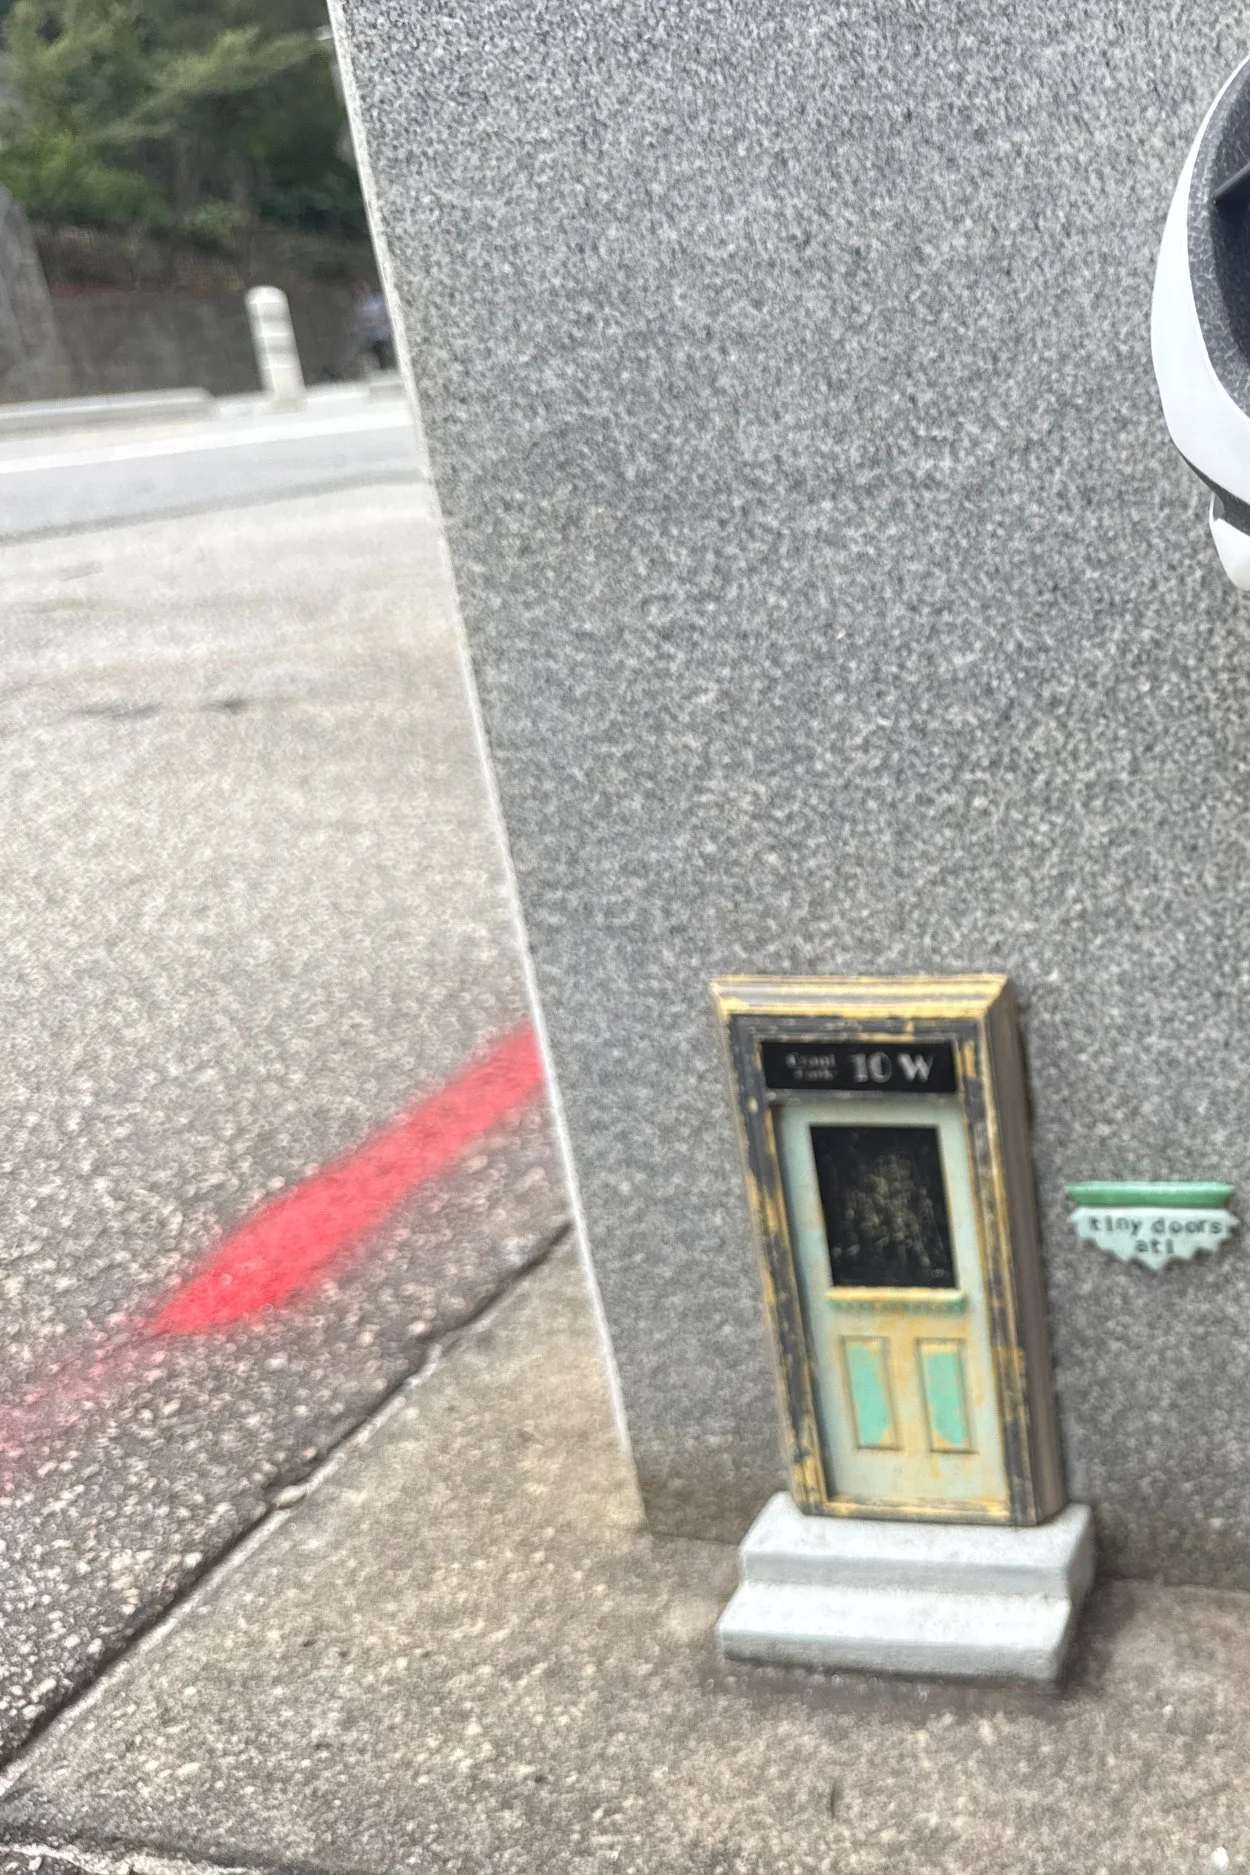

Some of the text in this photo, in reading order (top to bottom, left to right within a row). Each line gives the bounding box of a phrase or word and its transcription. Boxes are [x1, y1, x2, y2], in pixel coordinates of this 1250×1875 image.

[1089, 1215, 1222, 1235] tiny doors
[1135, 1238, 1174, 1254] atl
